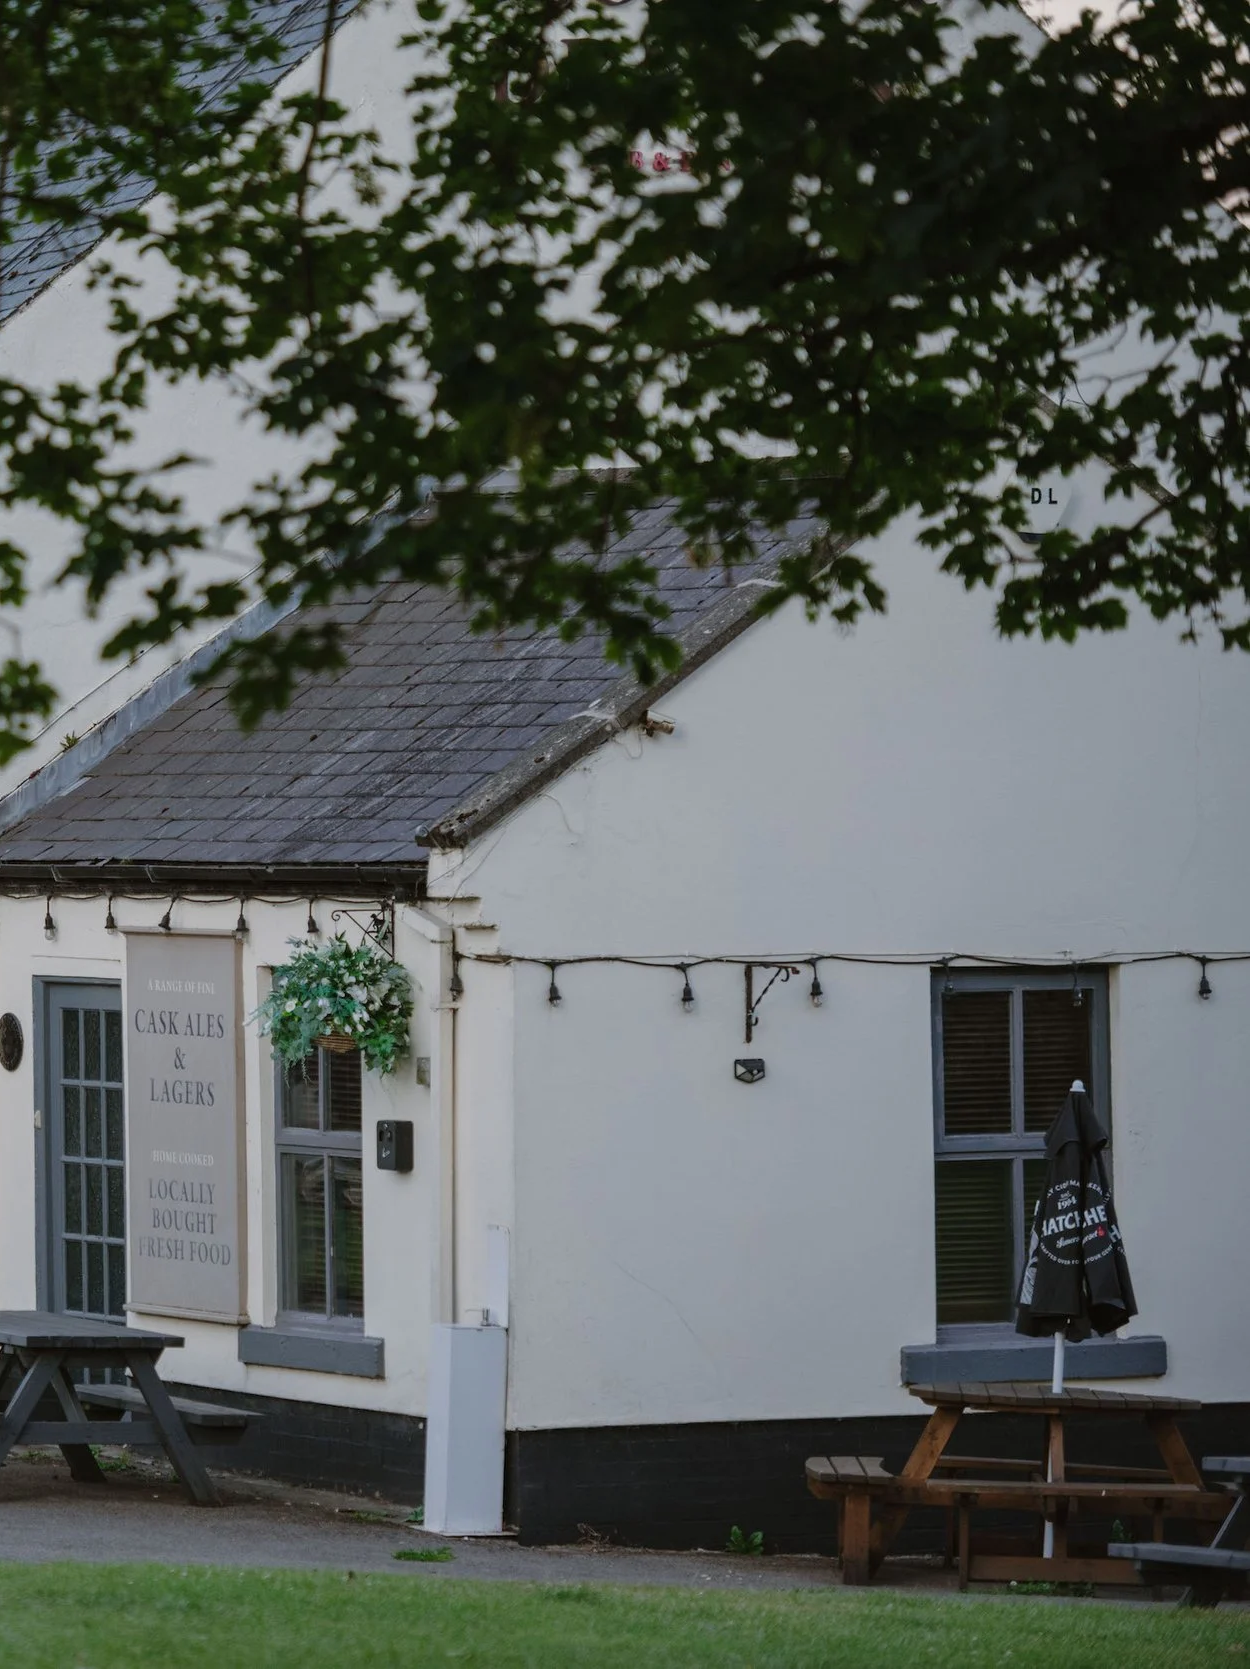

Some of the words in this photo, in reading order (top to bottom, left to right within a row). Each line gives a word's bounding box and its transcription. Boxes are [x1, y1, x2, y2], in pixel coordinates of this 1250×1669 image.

[155, 980, 182, 992] RANGE
[185, 981, 196, 993] OF
[135, 1009, 179, 1036] CASK
[184, 1012, 225, 1039] ALES
[174, 1046, 186, 1070] &
[150, 1078, 215, 1107] LAGERS
[152, 1150, 177, 1164] HOME
[178, 1152, 214, 1167] COOKED
[149, 1178, 215, 1205] LOCALLY
[152, 1208, 217, 1235] BOUGHT
[138, 1236, 185, 1260] FRESH
[189, 1241, 231, 1266] FOOD
